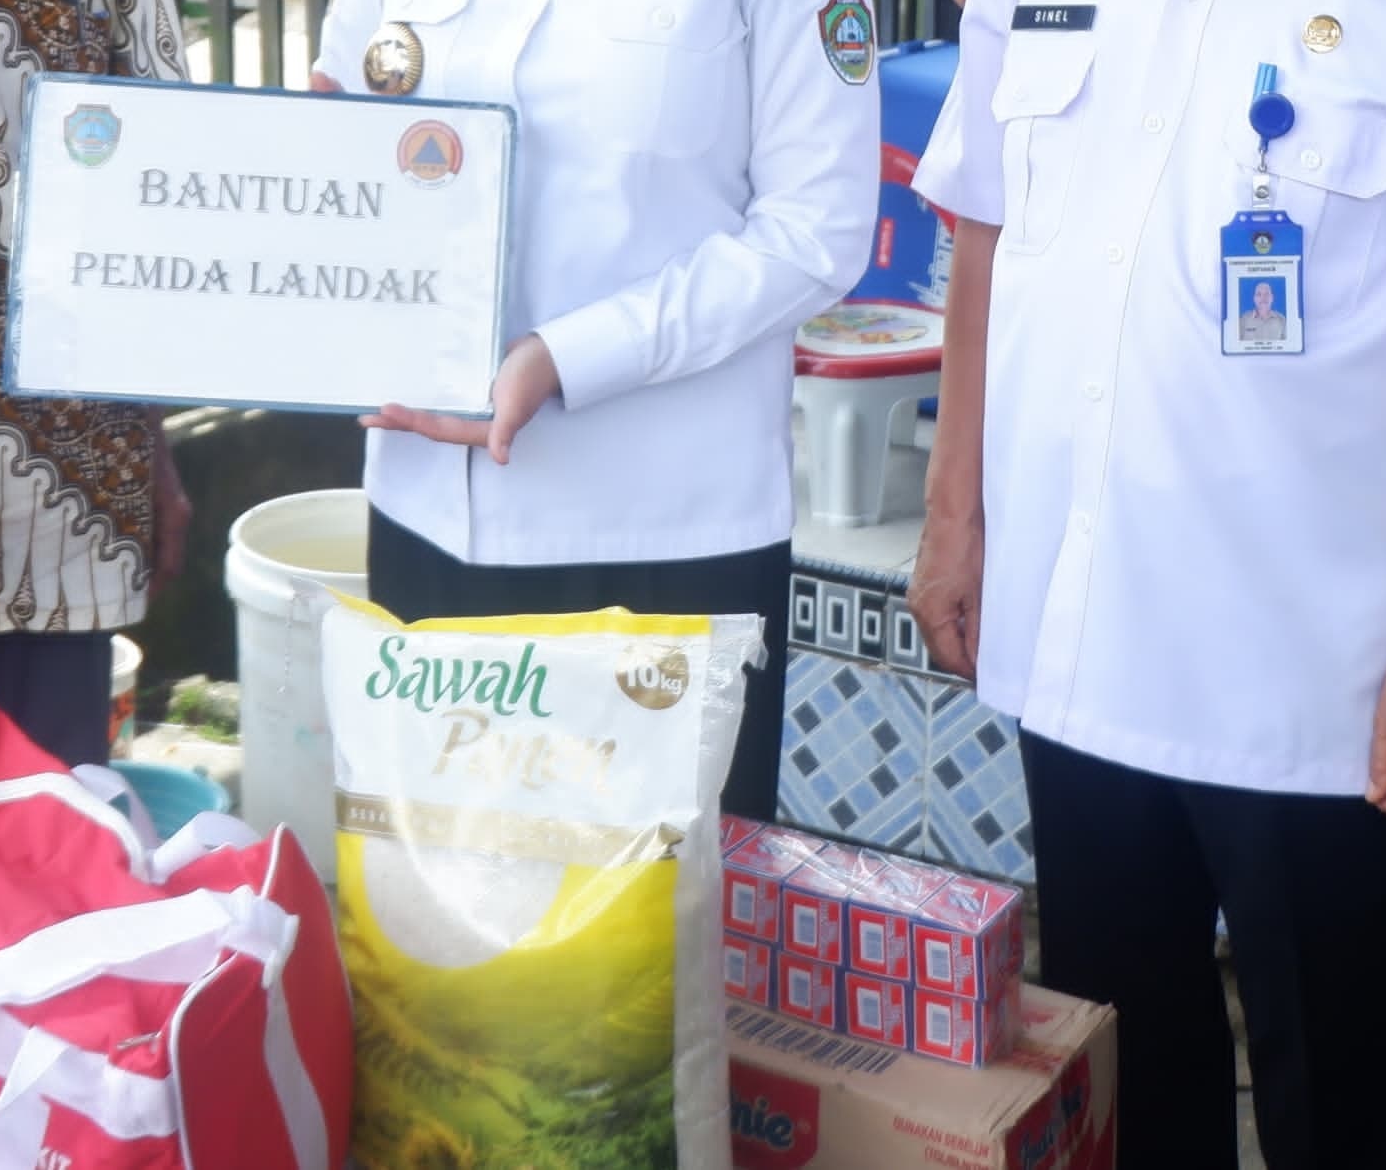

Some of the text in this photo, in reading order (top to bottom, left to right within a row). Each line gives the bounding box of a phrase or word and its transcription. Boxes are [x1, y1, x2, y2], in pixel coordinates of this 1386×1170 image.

[1034, 10, 1069, 23] SINEL
[139, 168, 385, 220] BANTUAN
[70, 251, 441, 305] PEMDA LANDAK
[365, 633, 553, 719] Sawah
